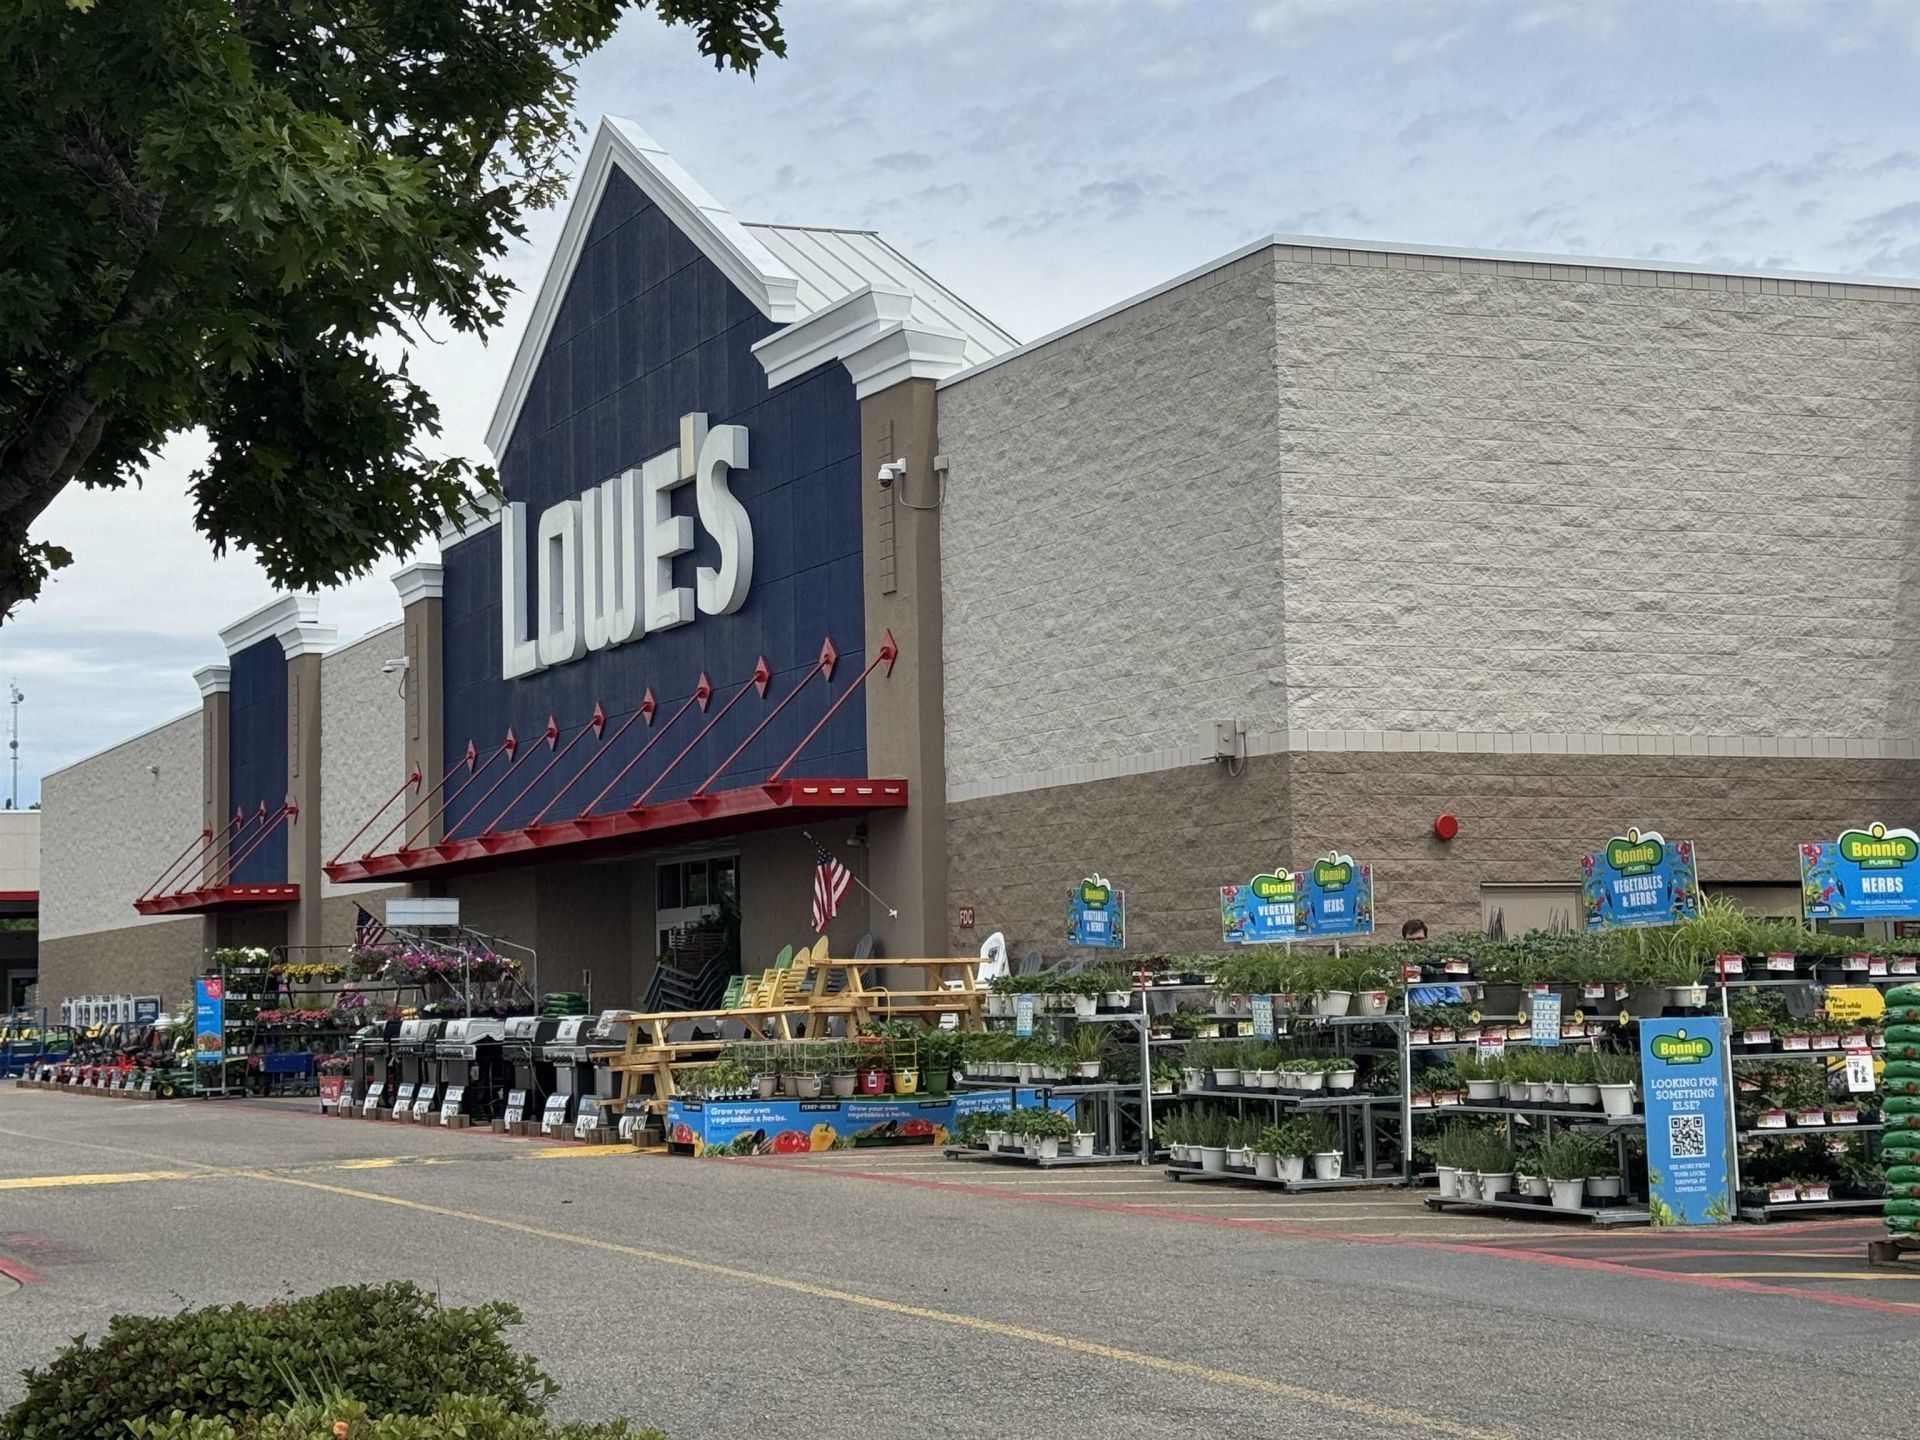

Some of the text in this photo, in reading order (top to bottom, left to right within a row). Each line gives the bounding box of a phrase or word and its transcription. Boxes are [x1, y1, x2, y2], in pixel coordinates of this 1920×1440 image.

[501, 412, 754, 681] LOWE'S
[1615, 847, 1654, 864] Bonnie
[1851, 841, 1906, 857] Bonnie
[1319, 867, 1346, 882] Bonnie
[1613, 875, 1663, 894] VEGETABLES
[1861, 877, 1904, 893] HERBS
[1323, 898, 1345, 914] HERBS
[1622, 891, 1657, 908] & HERBS
[1660, 1042, 1703, 1055] Bonnie
[1651, 1077, 1718, 1088] LOOKING FOR
[1656, 1089, 1715, 1100] SOMETHING
[711, 1107, 733, 1115] Grow
[734, 1108, 752, 1116] your
[1672, 1101, 1700, 1110] ELSE?
[711, 1116, 754, 1125] vegetables
